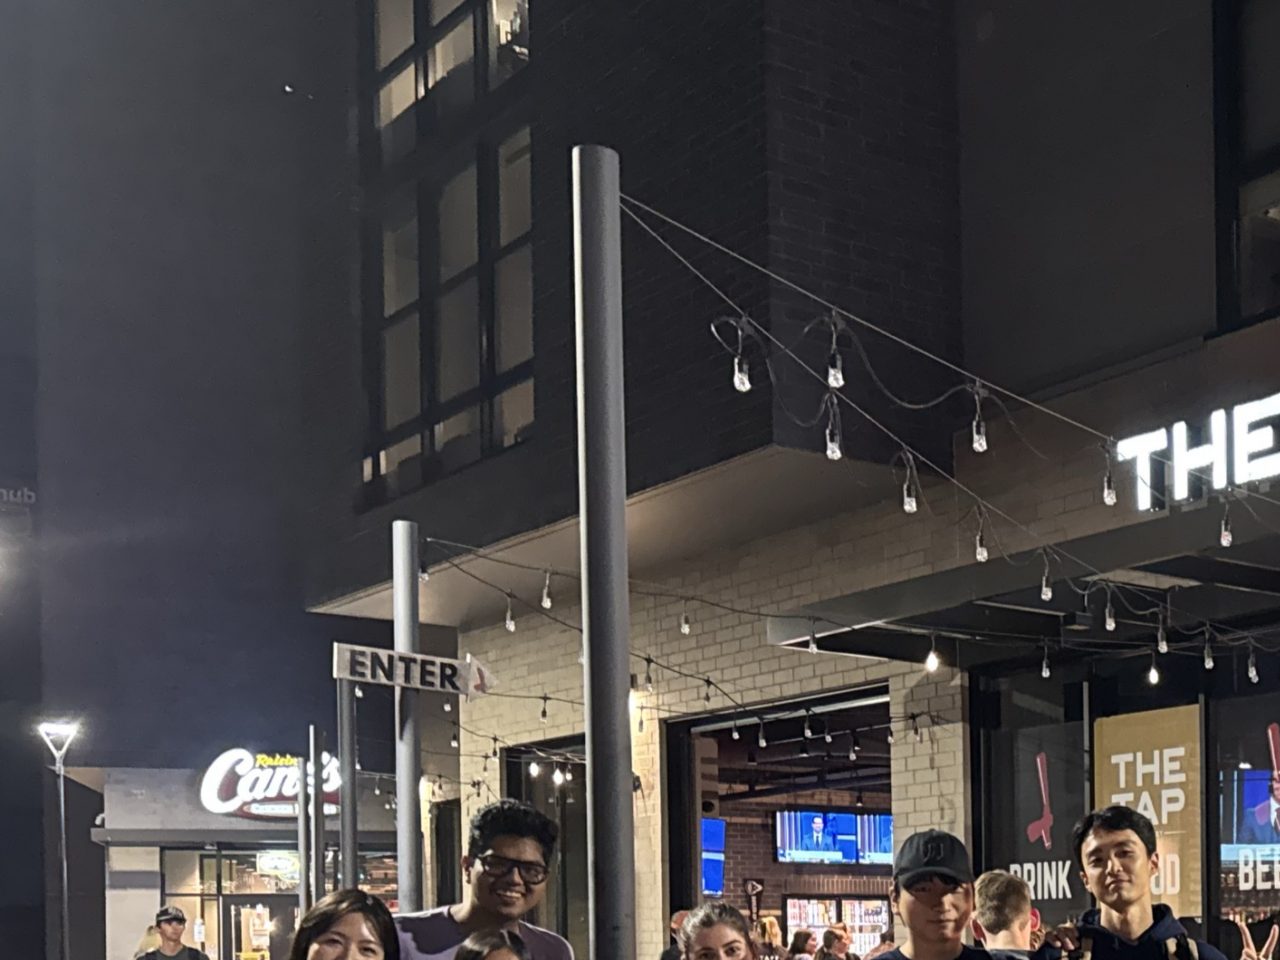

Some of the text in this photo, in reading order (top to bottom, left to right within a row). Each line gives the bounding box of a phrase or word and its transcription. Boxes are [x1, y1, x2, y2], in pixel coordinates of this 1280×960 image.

[350, 649, 460, 691] ENTER
[201, 748, 342, 814] Can's
[1111, 747, 1187, 788] THE
